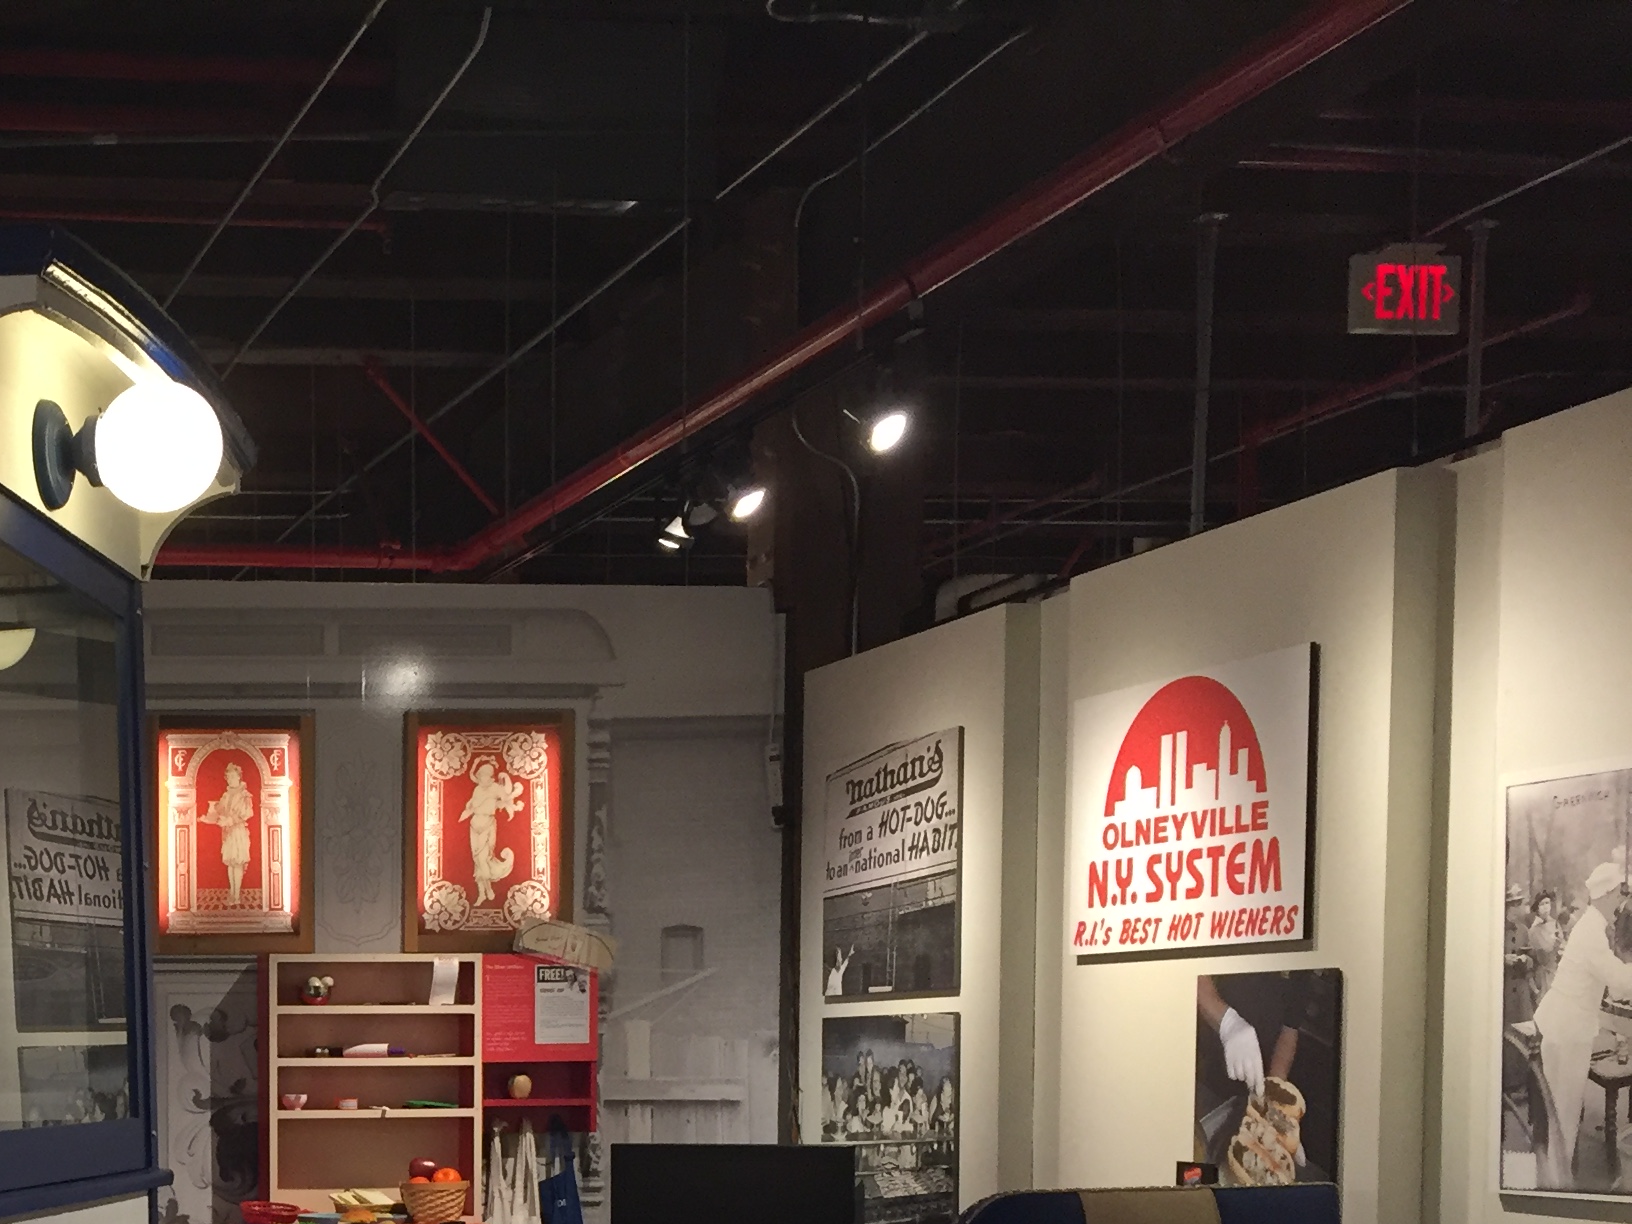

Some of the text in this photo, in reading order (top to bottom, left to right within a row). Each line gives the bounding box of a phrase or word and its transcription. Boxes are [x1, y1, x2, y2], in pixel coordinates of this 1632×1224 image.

[1374, 263, 1448, 320] EXIT
[839, 828, 863, 850] from
[866, 826, 874, 841] a
[1102, 800, 1270, 851] OLNEYVILLE
[854, 838, 906, 874] national
[1087, 836, 1282, 909] N.Y. SYSTEM
[1119, 917, 1163, 945] BEST
[1166, 911, 1205, 942] HOT
[1210, 904, 1300, 940] WIENERS
[538, 968, 565, 981] FREE!
